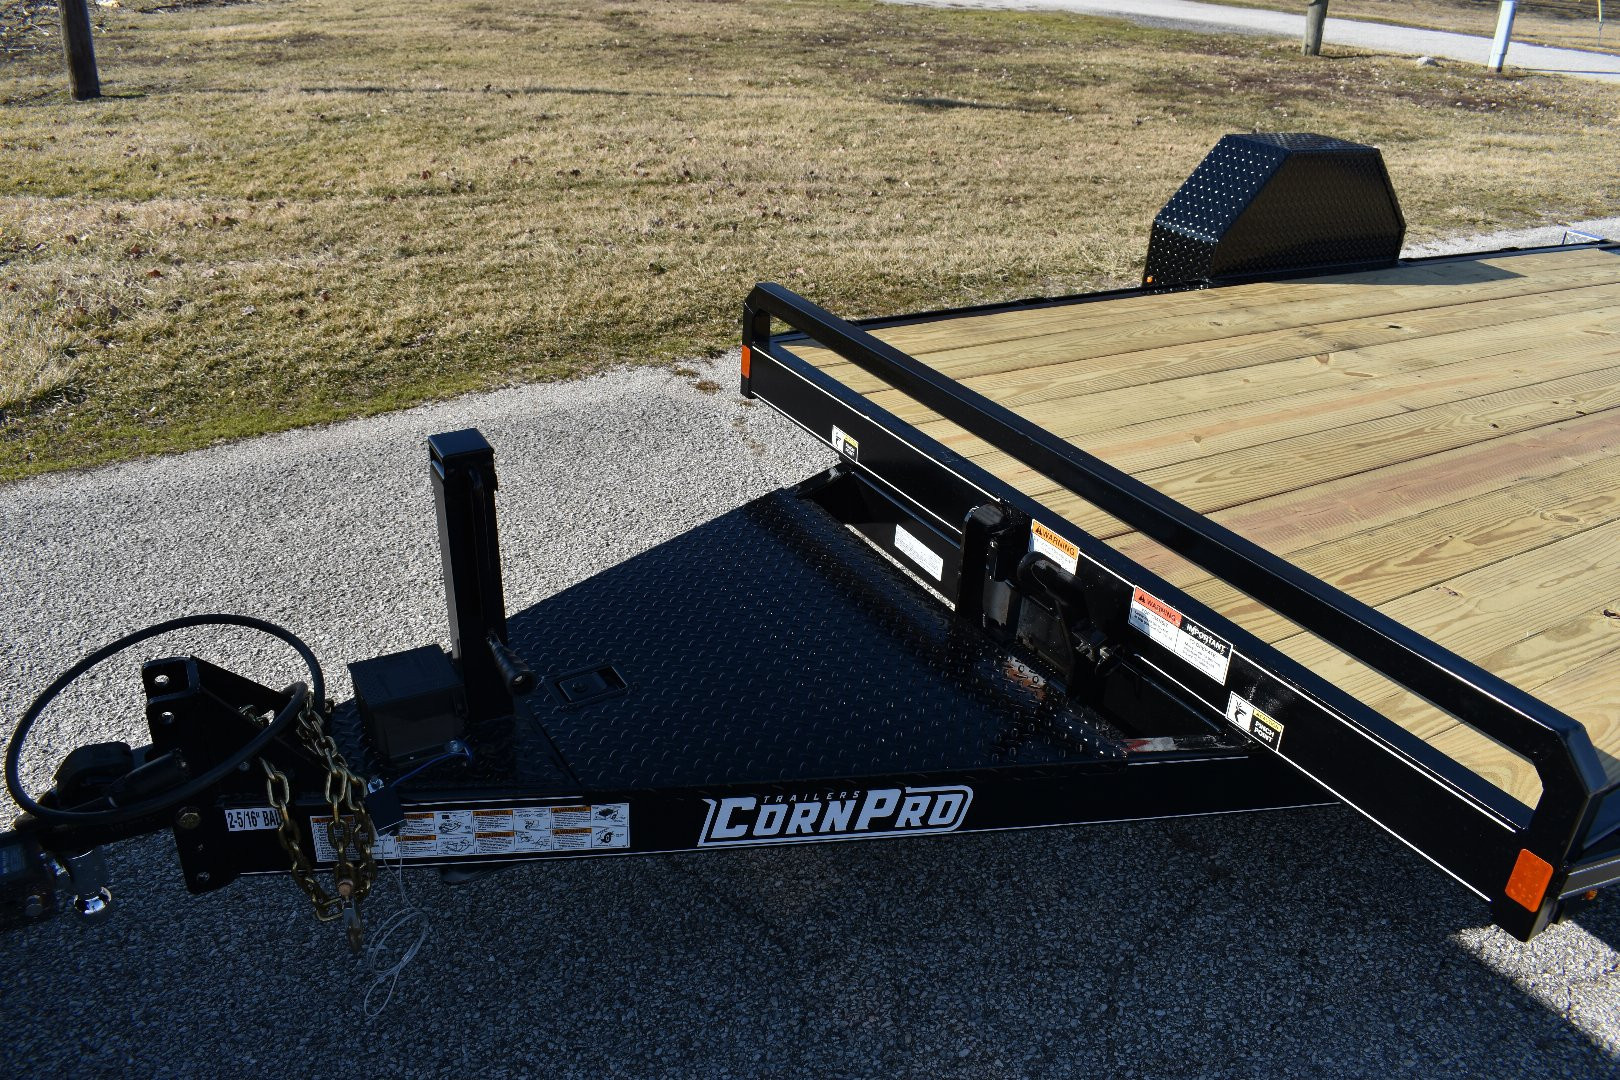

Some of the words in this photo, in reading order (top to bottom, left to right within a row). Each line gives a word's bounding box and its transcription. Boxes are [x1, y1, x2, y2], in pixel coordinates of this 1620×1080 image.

[1042, 529, 1075, 556] WARNING
[1147, 600, 1176, 622] WARNING
[1186, 623, 1226, 654] IMPORTANT
[1253, 726, 1273, 743] POINT
[1254, 720, 1274, 737] PINCH
[763, 790, 861, 804] TRAILERS
[228, 811, 260, 829] 2-5/16"
[262, 809, 280, 827] BAL
